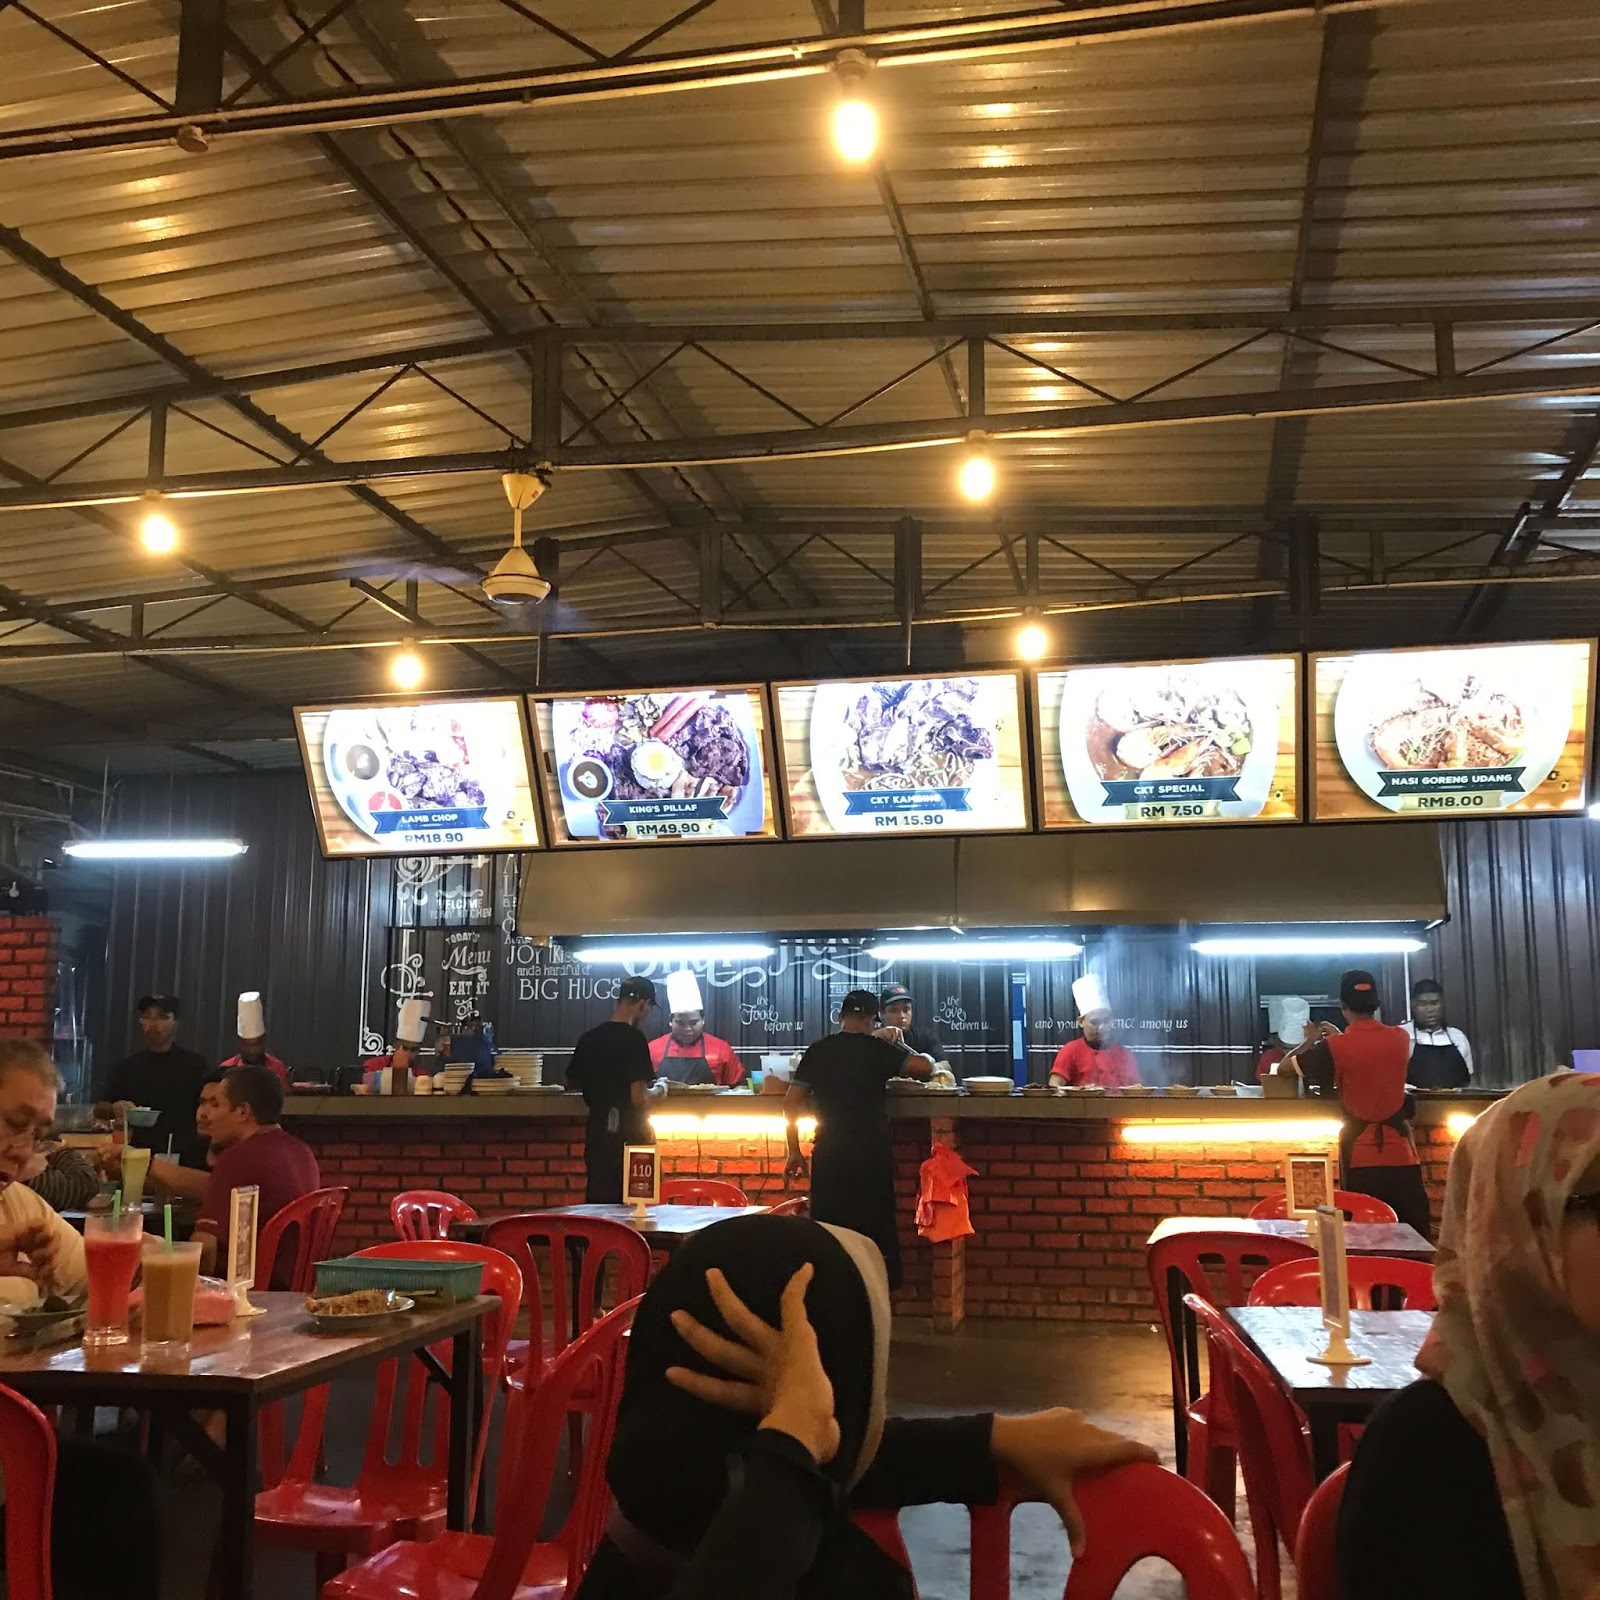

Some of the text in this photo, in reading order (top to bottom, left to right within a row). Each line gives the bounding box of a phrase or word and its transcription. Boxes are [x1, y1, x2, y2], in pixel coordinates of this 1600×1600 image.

[1391, 773, 1513, 786] NASI GORENG UDANG
[1157, 784, 1205, 794] SPECIAL
[1417, 795, 1484, 808] RM8.00
[628, 803, 698, 814] KING'S PILLAF
[1140, 805, 1204, 817] RM 7.50
[401, 813, 459, 824] LAMB CHOP
[874, 814, 944, 827] RM 15.90
[635, 822, 700, 835] RM49.90
[404, 832, 464, 844] RM18.90
[445, 932, 480, 944] TODAY'S
[441, 945, 491, 971] Menu
[448, 980, 473, 996] EAT
[518, 977, 622, 1001] BIG HUGS
[756, 994, 769, 1006] the
[947, 994, 960, 1006] the
[763, 1020, 793, 1035] before
[950, 1019, 980, 1031] between
[1034, 1016, 1054, 1030] and
[1139, 1017, 1172, 1033] among
[1175, 1018, 1188, 1030] us
[632, 1164, 652, 1178] 110
